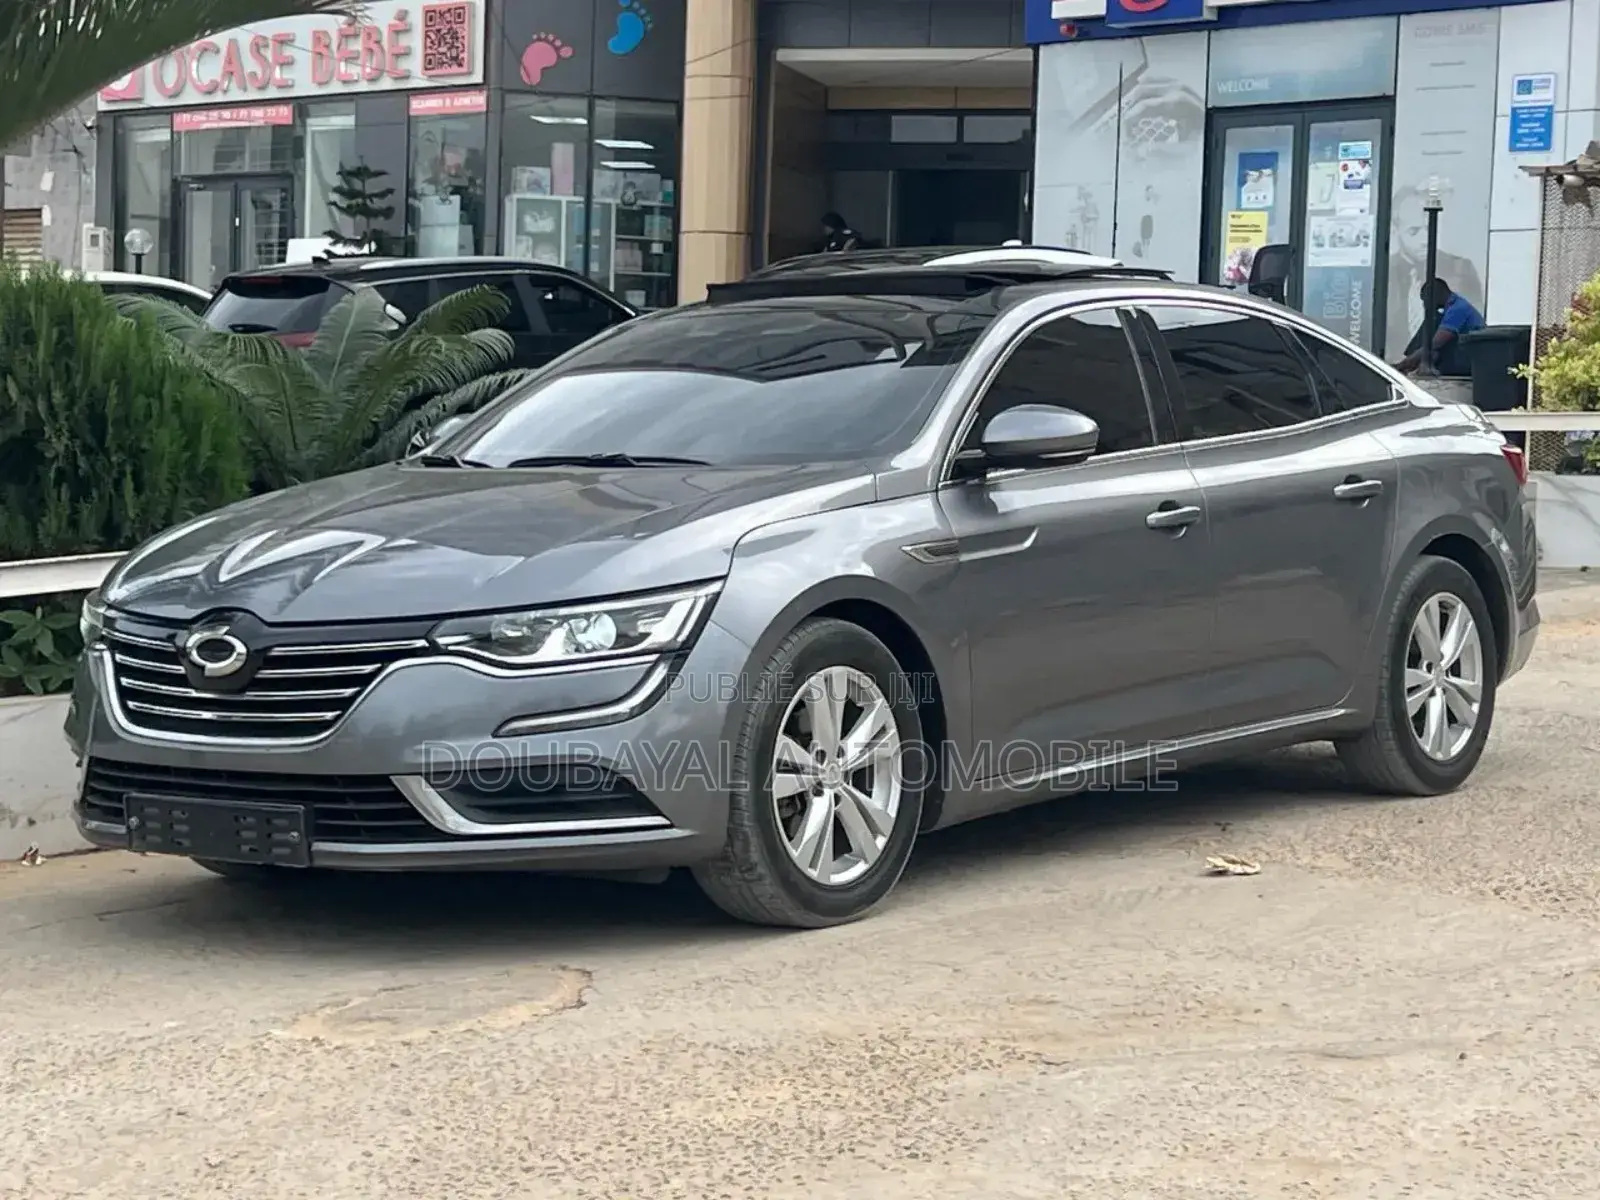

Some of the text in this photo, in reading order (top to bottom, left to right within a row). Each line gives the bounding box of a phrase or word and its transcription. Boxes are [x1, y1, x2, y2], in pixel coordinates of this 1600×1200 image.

[152, 9, 412, 98] OCASE BÉBÉ
[1216, 77, 1271, 94] WELCOME
[1349, 279, 1362, 345] WELCOME
